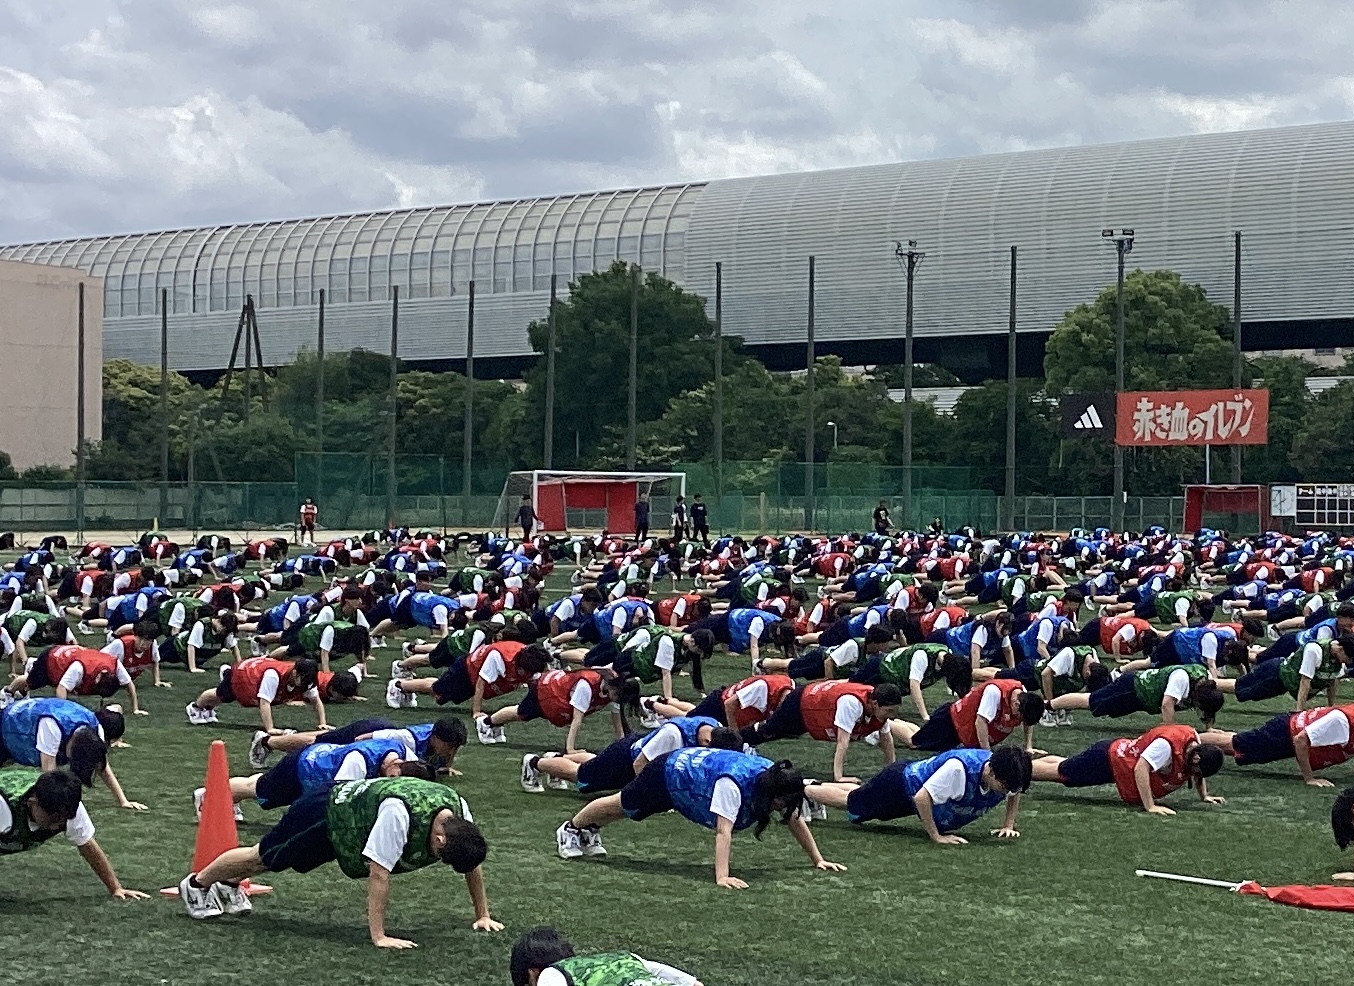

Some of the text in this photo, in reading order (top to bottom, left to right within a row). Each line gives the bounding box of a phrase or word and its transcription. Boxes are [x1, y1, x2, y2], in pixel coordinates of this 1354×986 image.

[1133, 393, 1255, 441] 赤き血のイレブン
